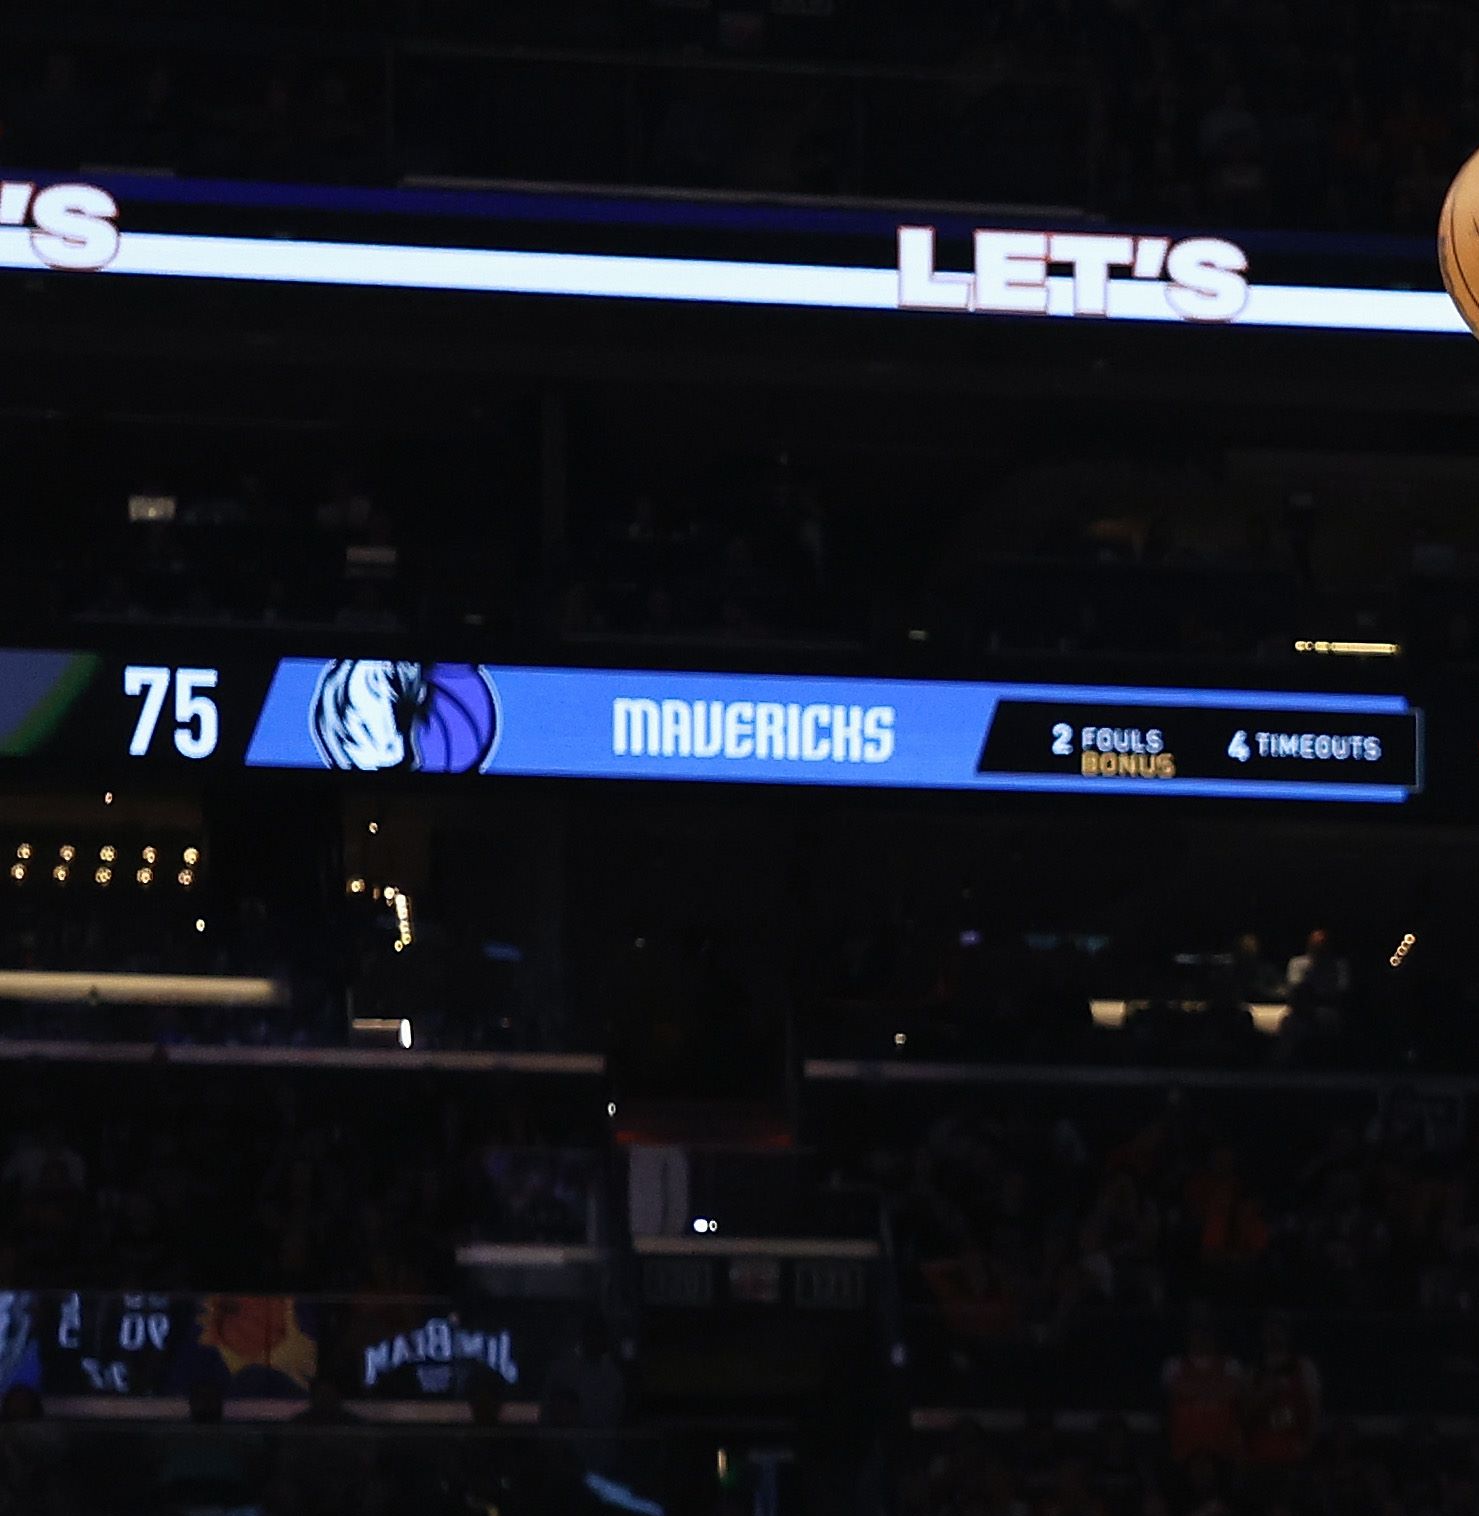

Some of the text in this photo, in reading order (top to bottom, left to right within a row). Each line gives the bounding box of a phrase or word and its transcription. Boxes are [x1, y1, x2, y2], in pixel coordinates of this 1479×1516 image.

[897, 224, 1249, 323] LET'S
[124, 665, 219, 759] 75
[612, 696, 896, 764] MAVERICKS
[1051, 722, 1164, 755] 2 FOULS
[1227, 729, 1382, 762] 4 TIMEOUTS
[1081, 751, 1176, 779] BONUS
